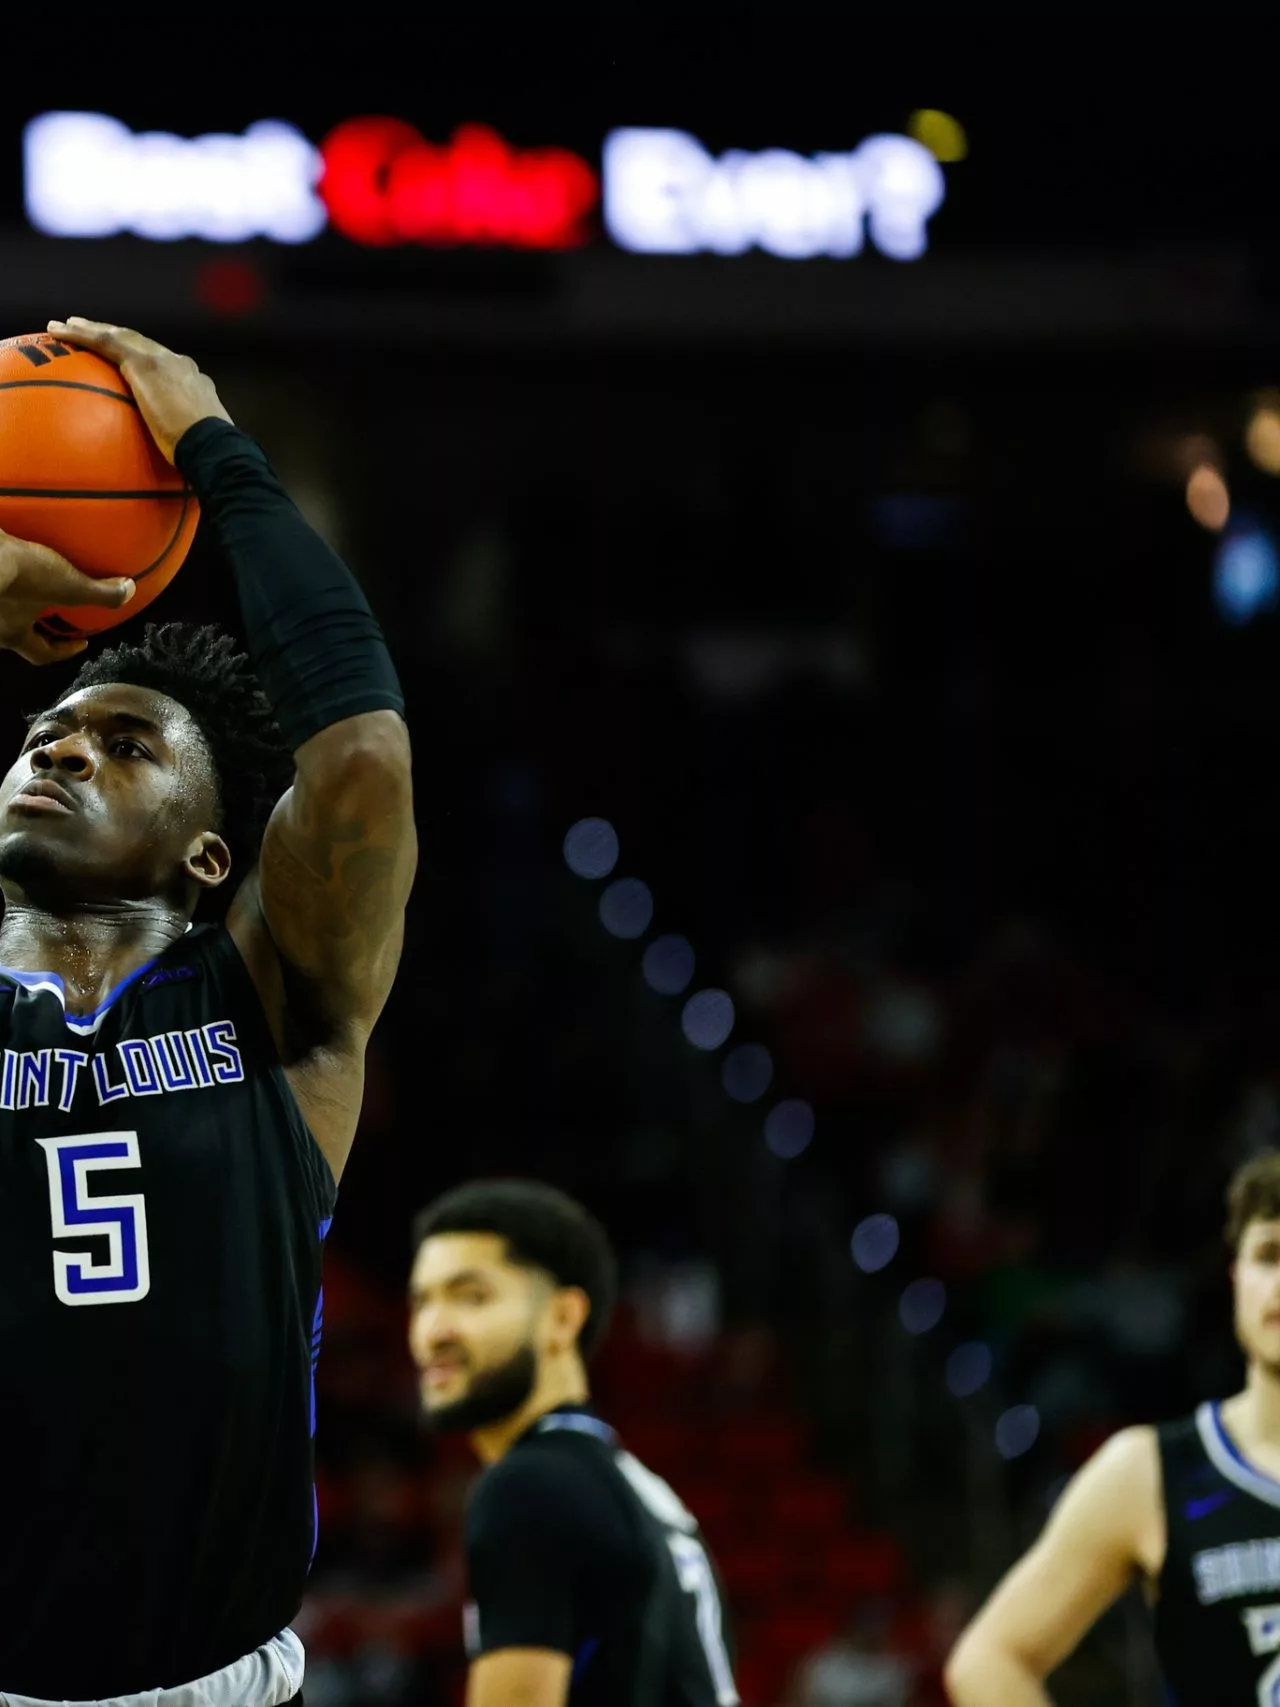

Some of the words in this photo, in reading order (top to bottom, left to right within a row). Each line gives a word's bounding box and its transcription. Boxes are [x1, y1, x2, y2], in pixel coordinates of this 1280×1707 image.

[22, 109, 324, 244] Best
[91, 1020, 245, 1106] LOUIS
[34, 1130, 151, 1307] 5
